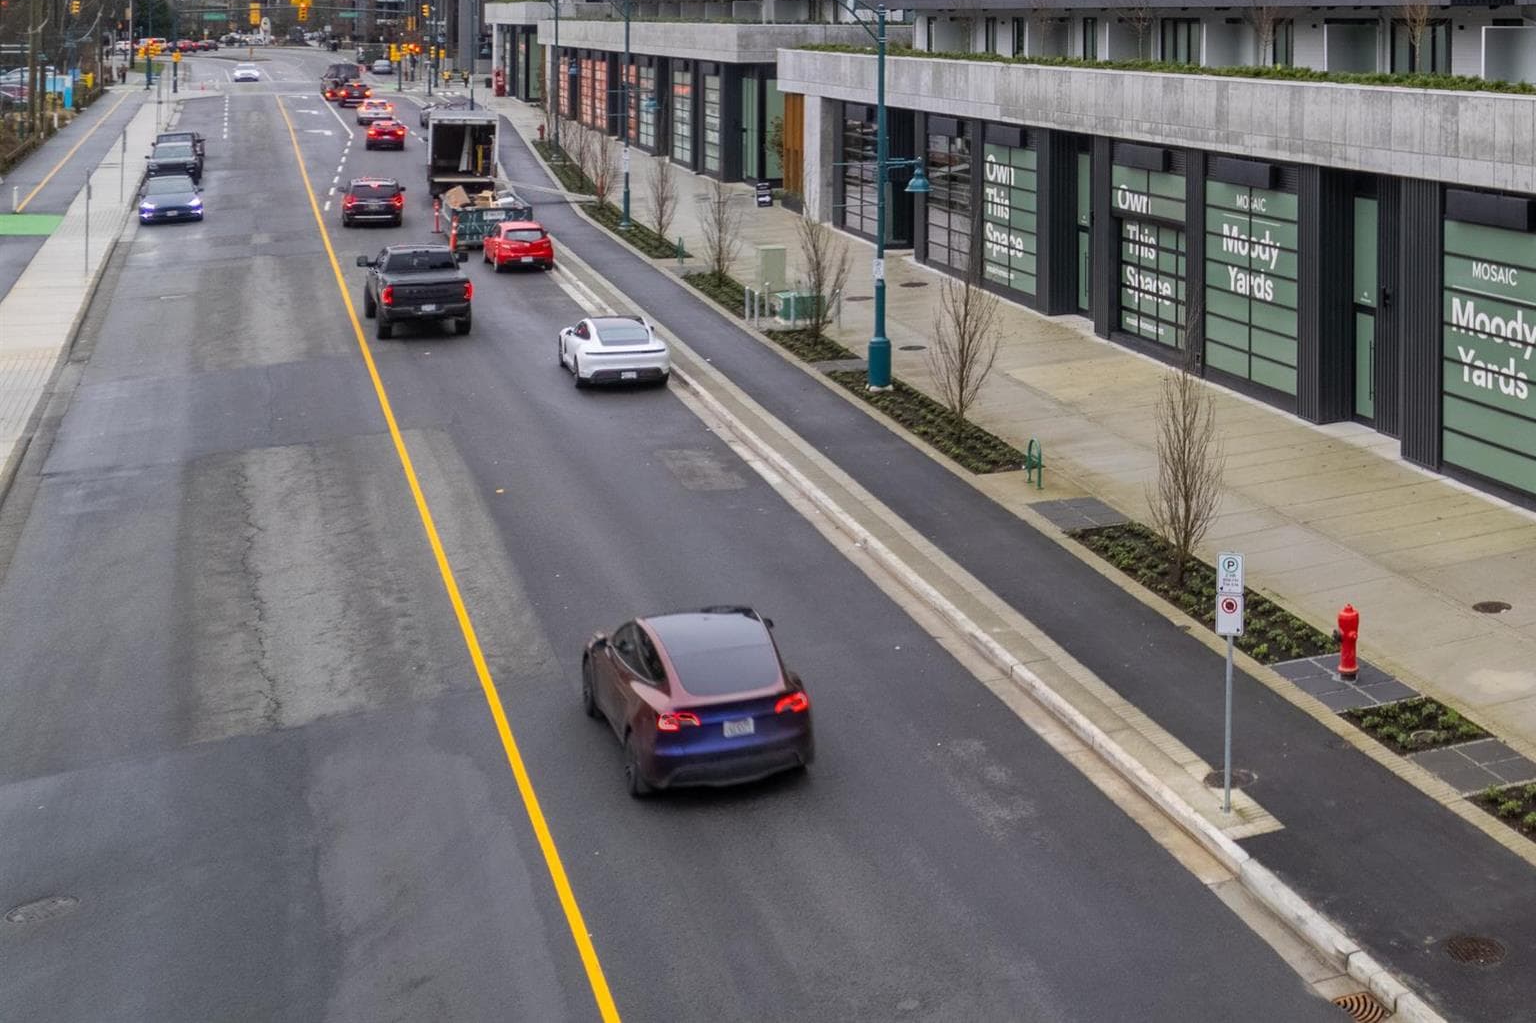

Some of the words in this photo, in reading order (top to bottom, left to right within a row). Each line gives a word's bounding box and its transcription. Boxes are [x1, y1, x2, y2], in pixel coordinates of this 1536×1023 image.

[986, 154, 1015, 186] Own
[986, 187, 1010, 220] This
[1118, 185, 1151, 215] Own
[986, 222, 1024, 259] Space
[1127, 224, 1156, 260] This
[1222, 223, 1280, 270] Moody
[1126, 265, 1171, 305] Space
[1228, 265, 1273, 301] Yards
[1472, 261, 1518, 286] MOSAIC
[1457, 345, 1529, 400] Yards
